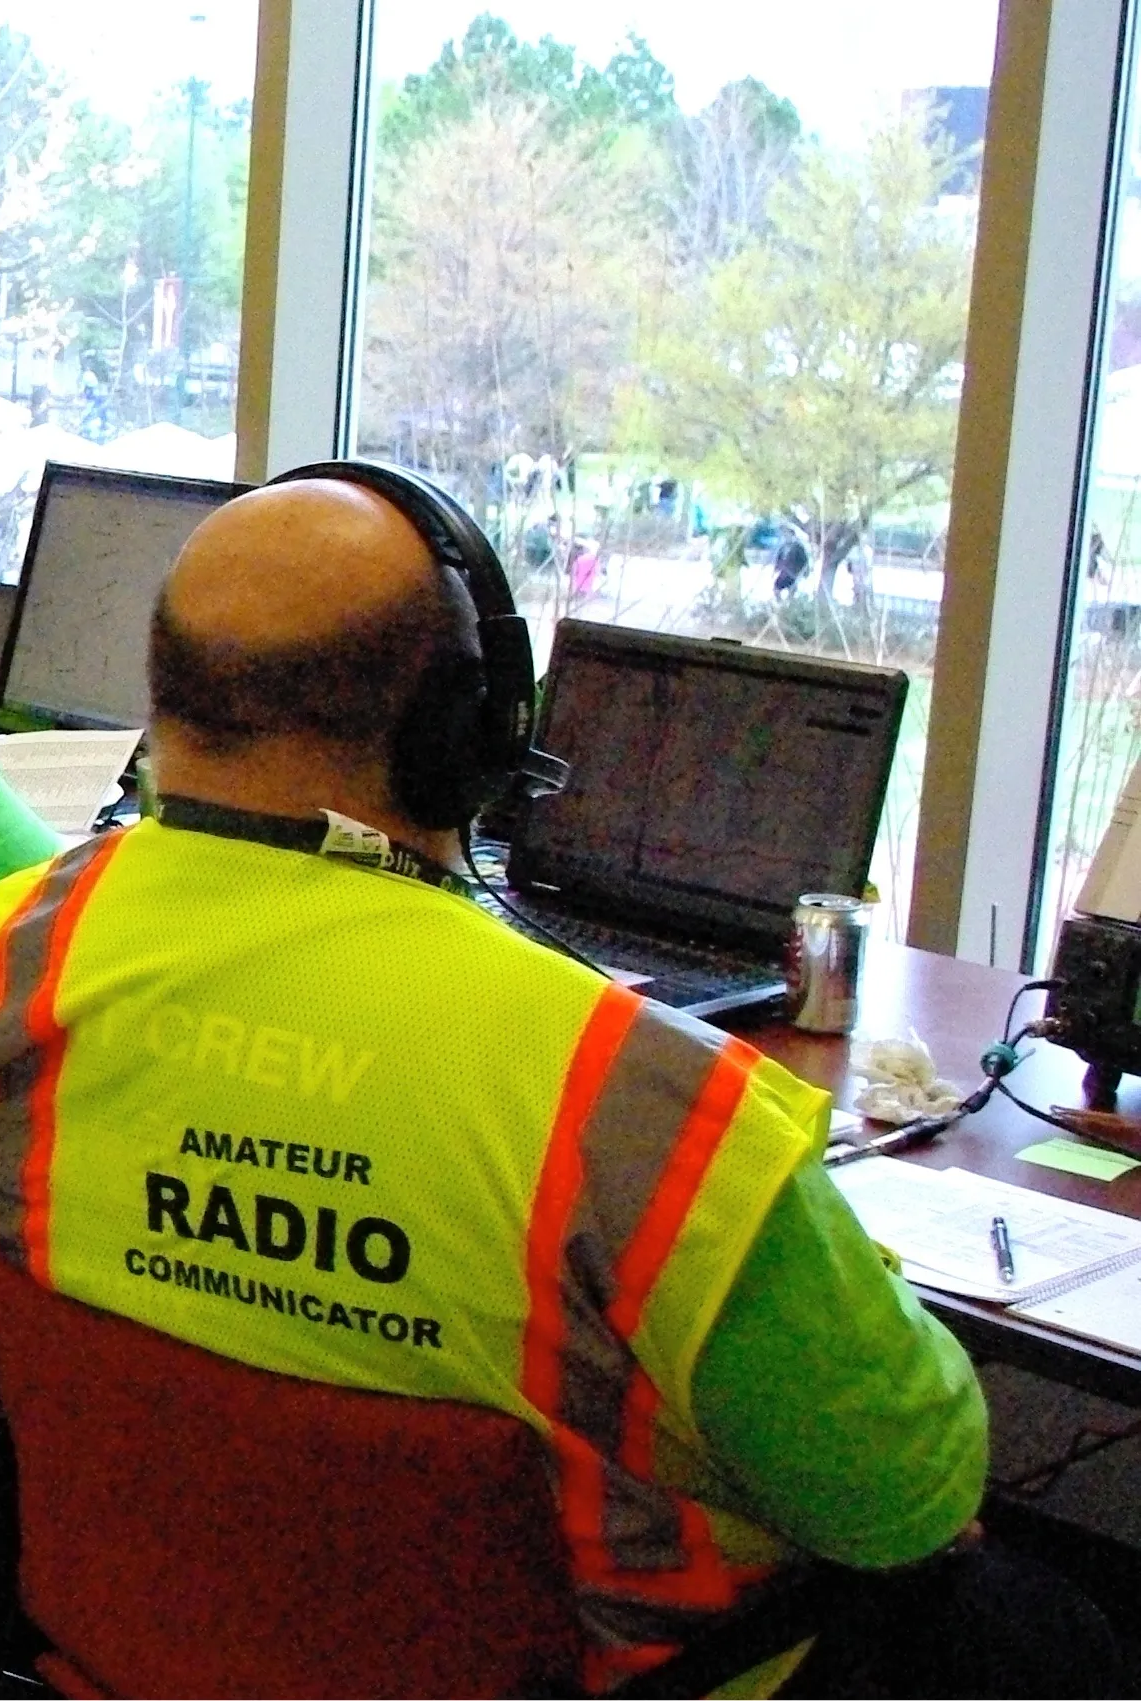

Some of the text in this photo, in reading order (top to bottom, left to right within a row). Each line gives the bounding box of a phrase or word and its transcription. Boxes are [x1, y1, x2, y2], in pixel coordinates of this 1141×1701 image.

[147, 1004, 378, 1103] CREW
[179, 1127, 373, 1186] AMATEUR
[145, 1171, 412, 1285] RADIO
[123, 1247, 443, 1349] COMMUNICATOR
